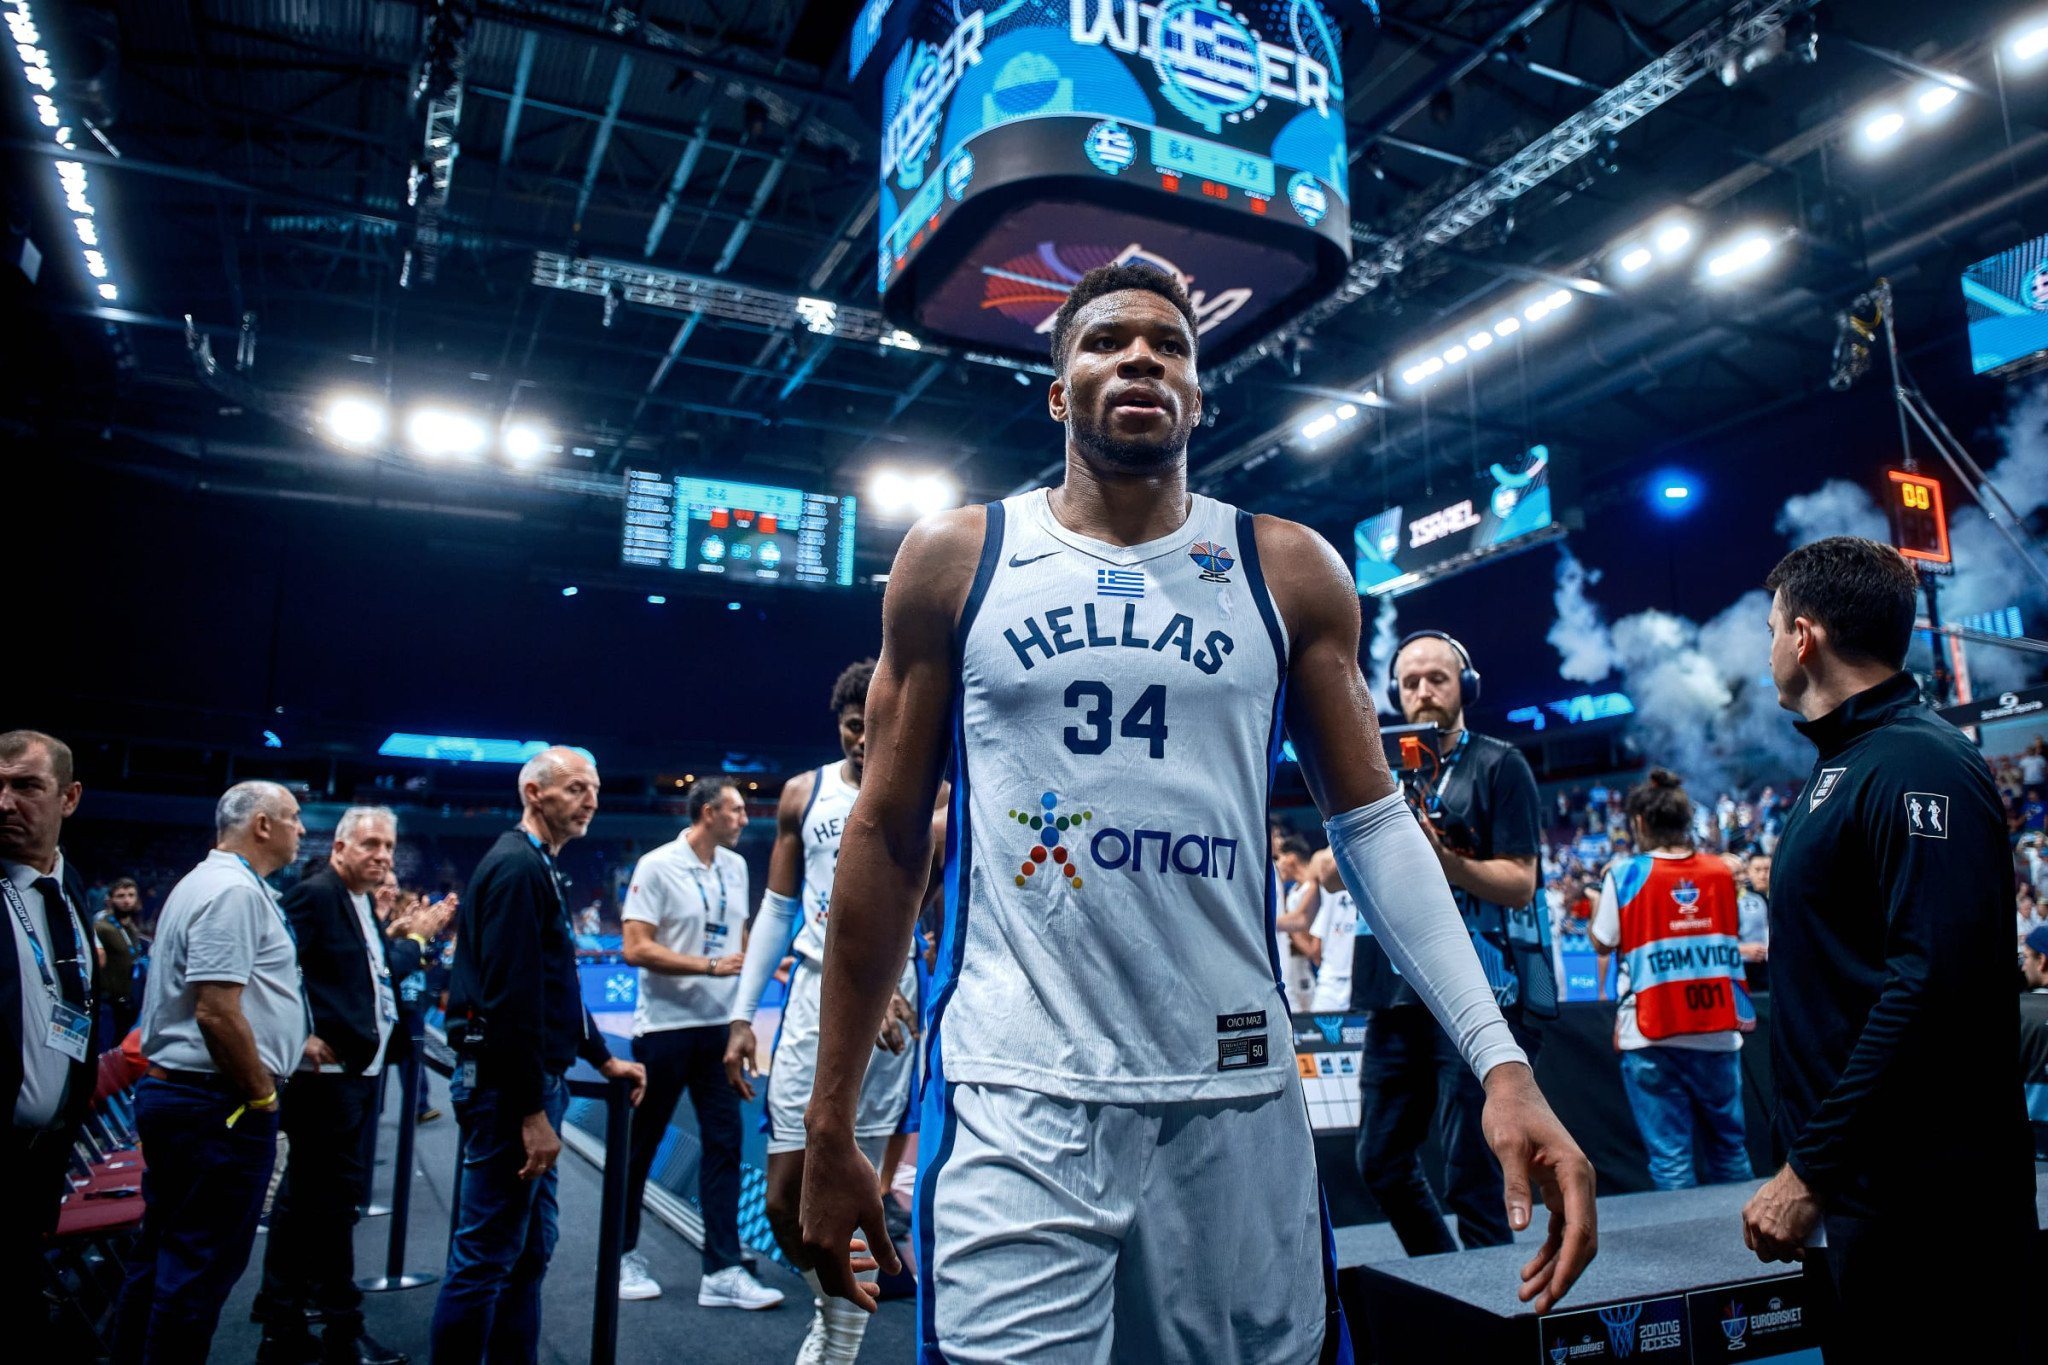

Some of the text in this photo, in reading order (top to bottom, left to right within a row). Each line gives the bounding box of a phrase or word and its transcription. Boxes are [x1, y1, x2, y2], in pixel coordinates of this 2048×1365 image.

[1901, 482, 1930, 511] 00
[1408, 499, 1481, 549] ISRAEL
[1003, 603, 1235, 675] HELLAS
[1063, 680, 1168, 759] 34
[1647, 947, 1693, 975] TEAM
[1252, 1044, 1264, 1058] 50
[1639, 1320, 1681, 1339] ZONING
[1750, 1307, 1802, 1330] EUROBASKET
[1640, 1334, 1681, 1352] ACCESS
